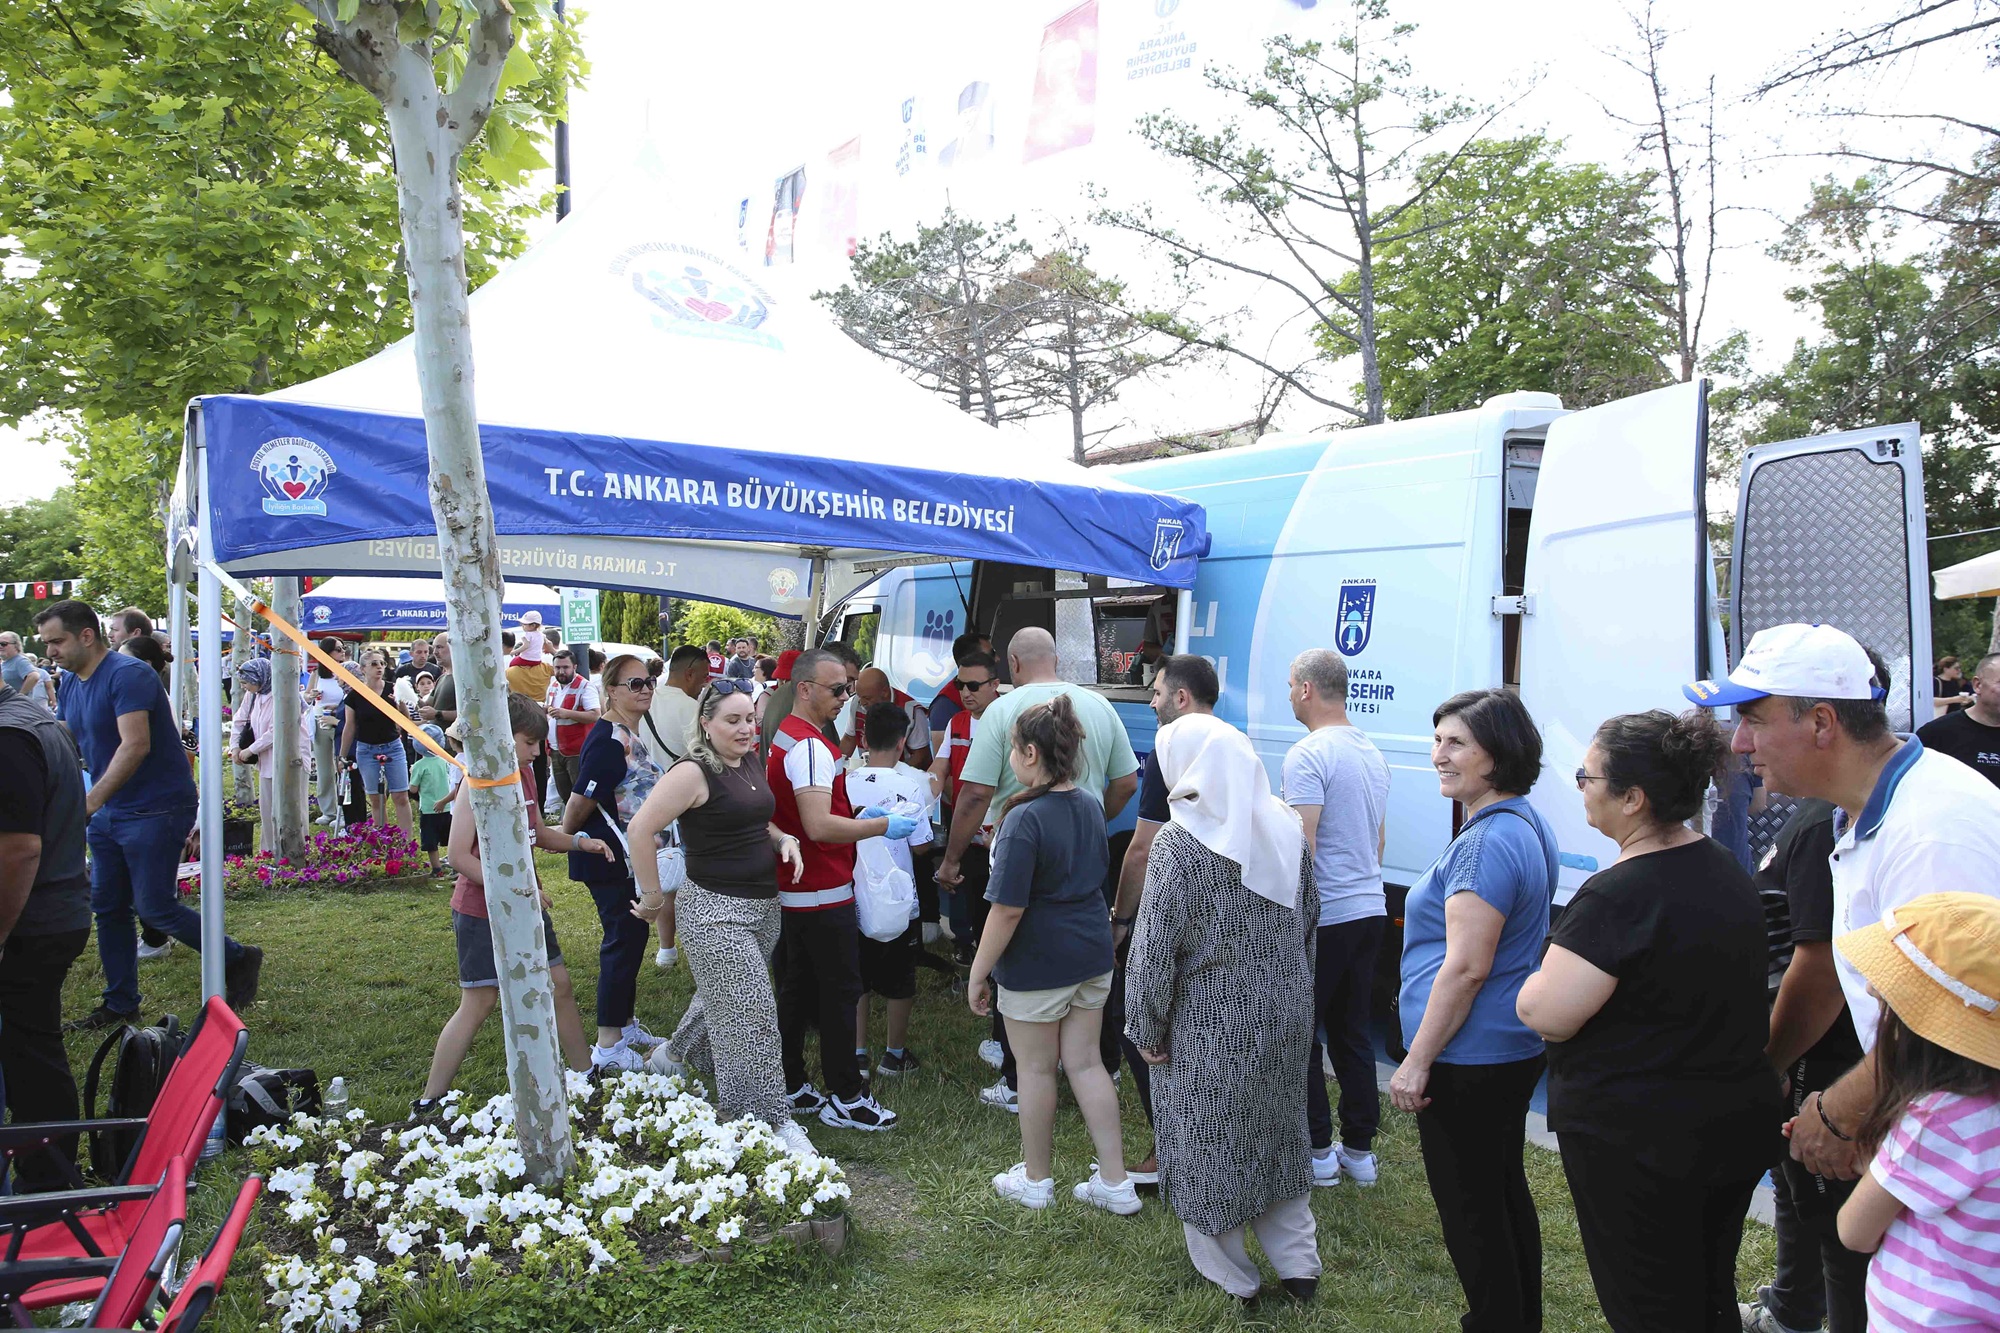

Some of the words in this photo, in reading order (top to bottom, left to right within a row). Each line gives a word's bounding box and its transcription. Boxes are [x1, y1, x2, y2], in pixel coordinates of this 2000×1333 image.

[251, 450, 266, 470] SOSYAL
[544, 467, 594, 497] T.C.
[603, 472, 719, 506] ANKARA
[727, 477, 886, 519] BÜYÜKŞEHİR
[892, 500, 1014, 533] BELEDİYESİ
[396, 610, 428, 618] ANKARA
[1347, 669, 1382, 680] NKARA
